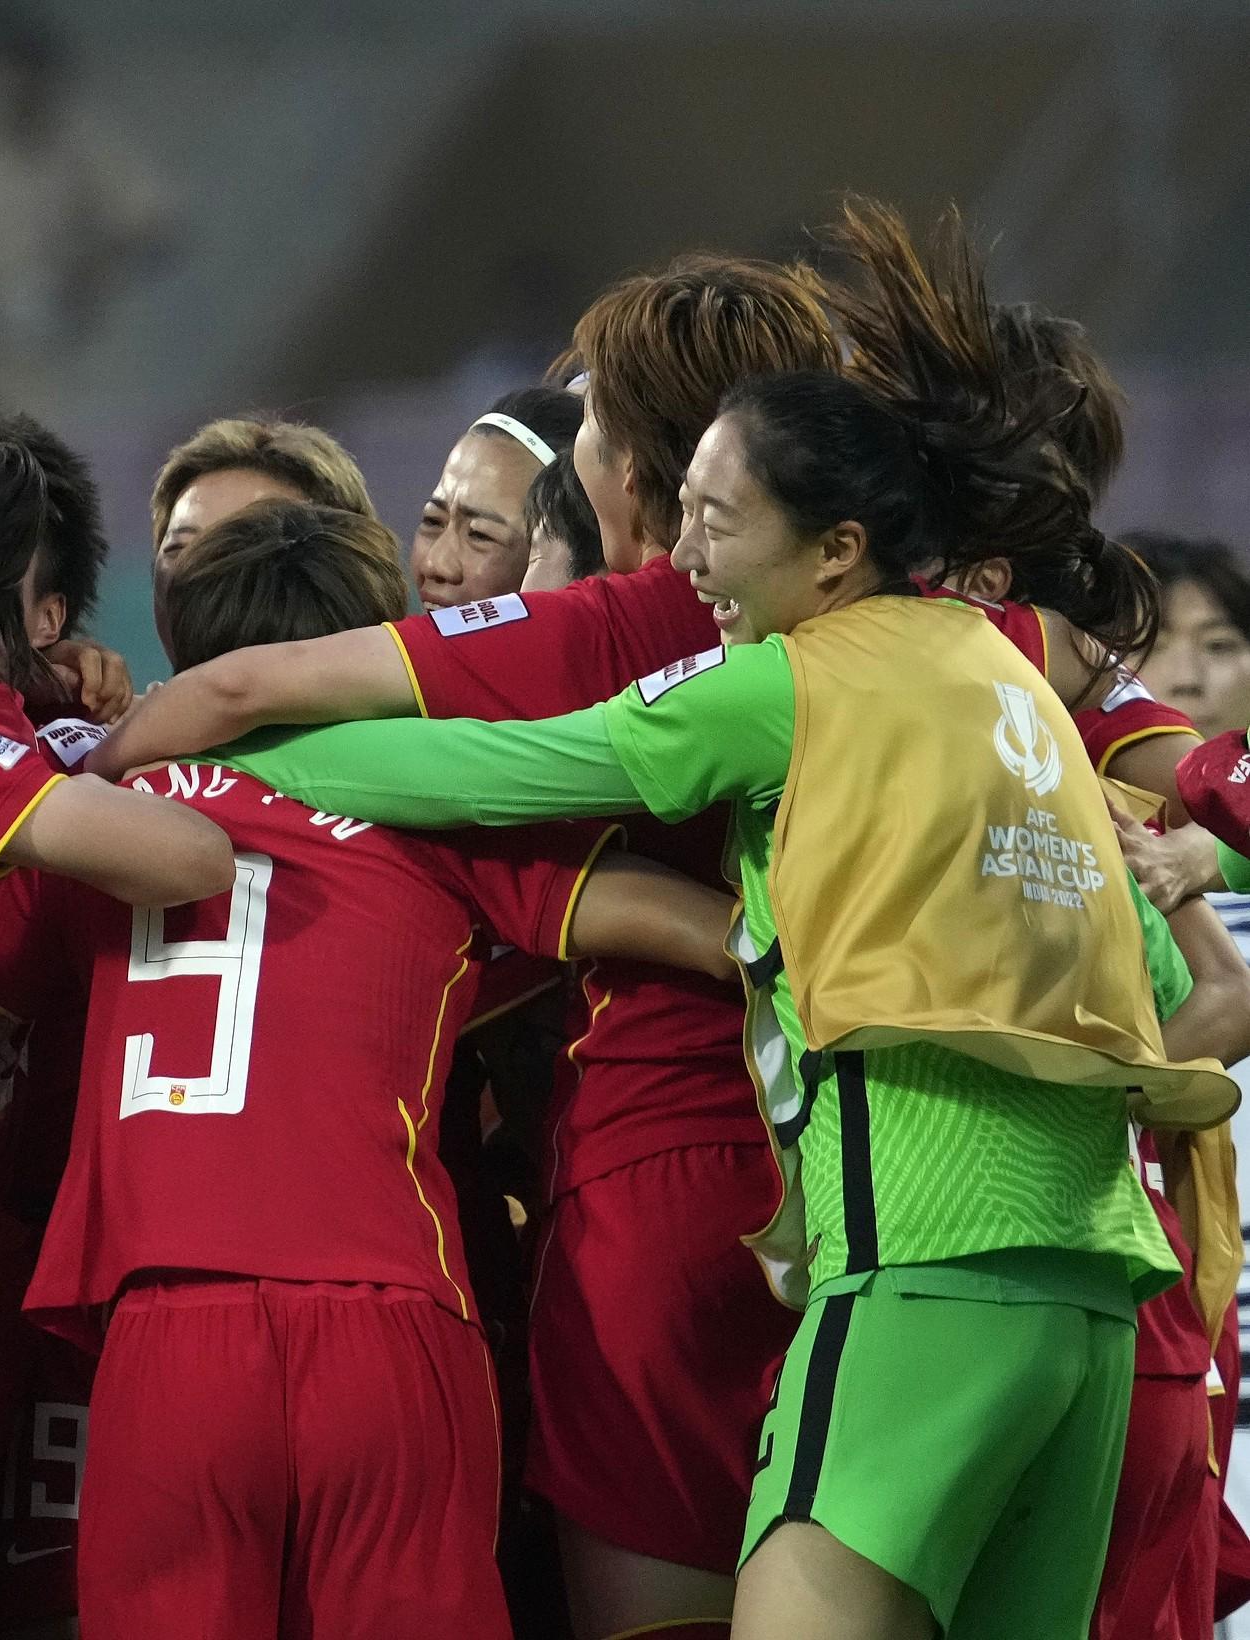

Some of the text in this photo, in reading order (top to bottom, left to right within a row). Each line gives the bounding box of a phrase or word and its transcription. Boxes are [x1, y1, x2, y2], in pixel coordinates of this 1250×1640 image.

[459, 607, 480, 624] ALL
[477, 601, 500, 623] GOAL
[60, 731, 86, 748] FOR
[132, 763, 240, 799] ANG
[1026, 807, 1058, 833] AFC
[987, 825, 1098, 867] WOMEN'S
[981, 853, 1105, 892] ASIAN CUP
[119, 852, 273, 1121] 9
